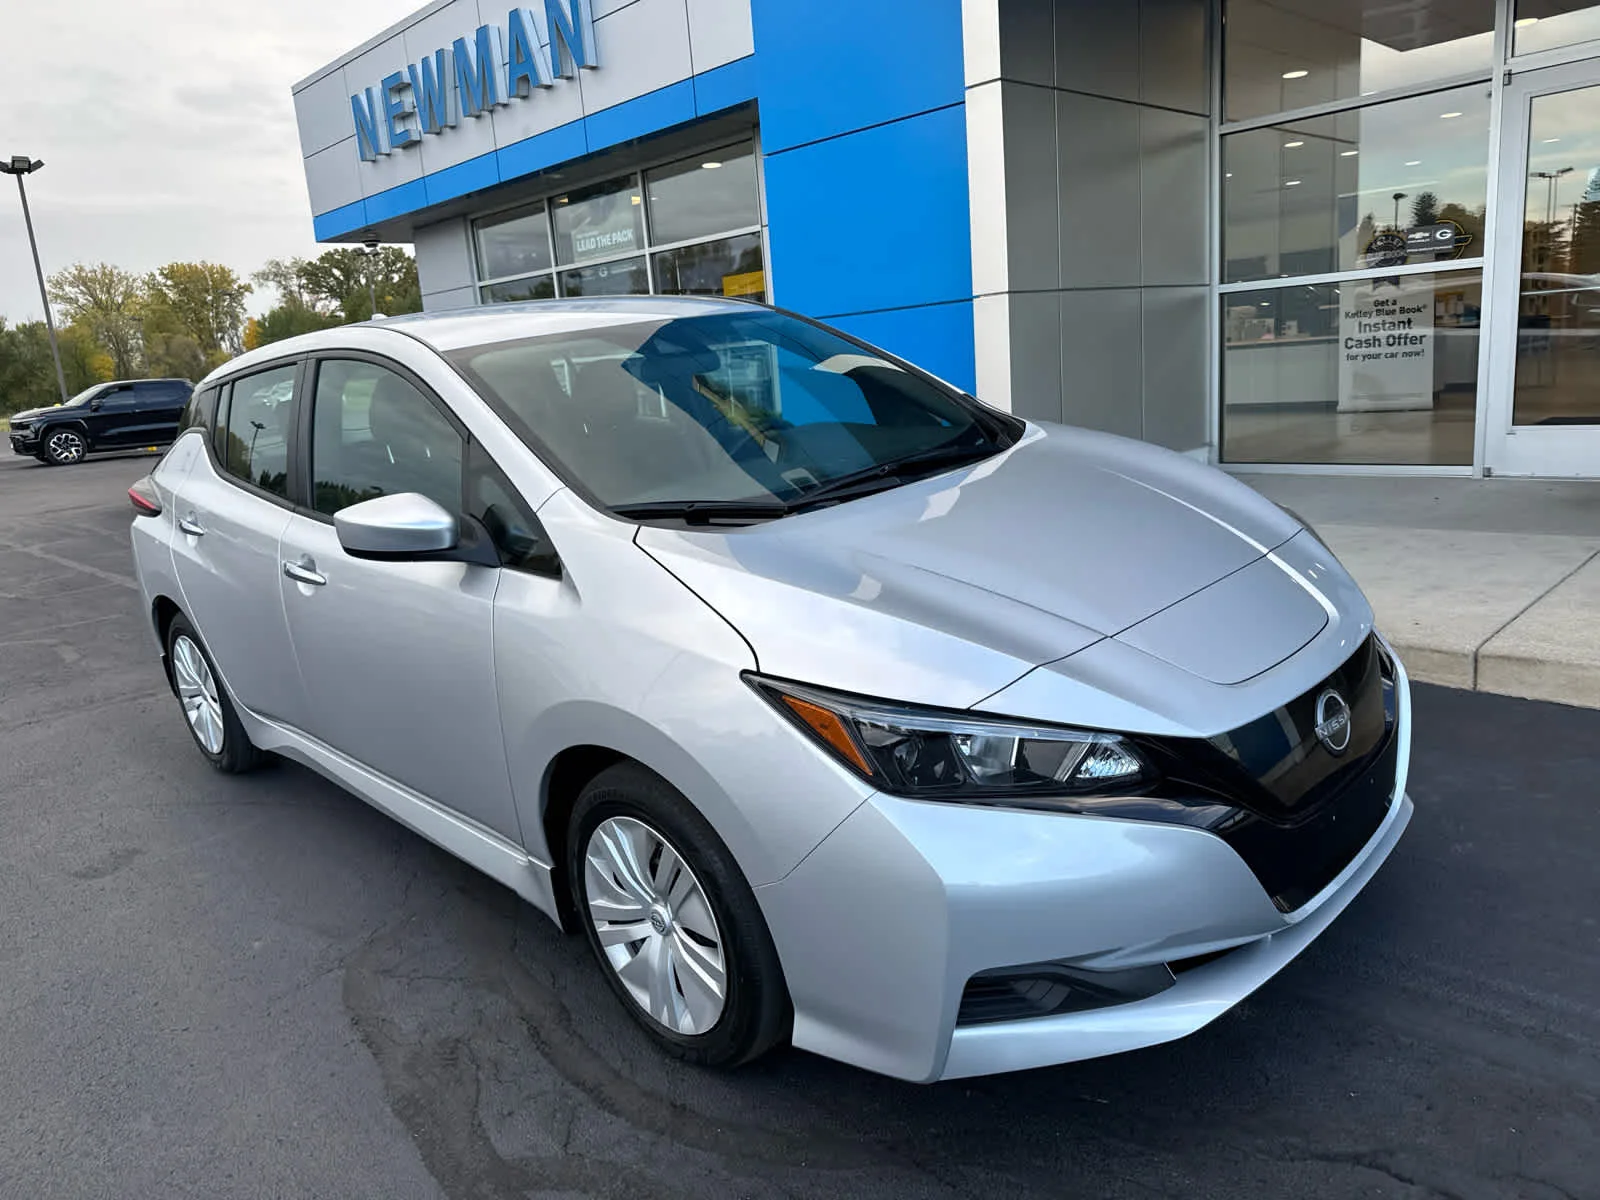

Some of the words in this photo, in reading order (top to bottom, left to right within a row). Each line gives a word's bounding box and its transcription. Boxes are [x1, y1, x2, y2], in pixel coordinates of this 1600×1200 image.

[351, 0, 598, 161] NEWMAN
[577, 238, 596, 252] LEAD
[596, 234, 612, 248] THE
[612, 229, 633, 244] PACK
[1373, 299, 1390, 308] Get
[1345, 309, 1374, 319] Kelley
[1375, 308, 1397, 317] Blue
[1358, 317, 1414, 334] Instant
[1344, 336, 1382, 350] Cash
[1386, 333, 1427, 347] Offer
[1346, 352, 1359, 361] for
[1361, 352, 1381, 362] your
[1384, 351, 1399, 359] car
[1401, 349, 1425, 358] now!
